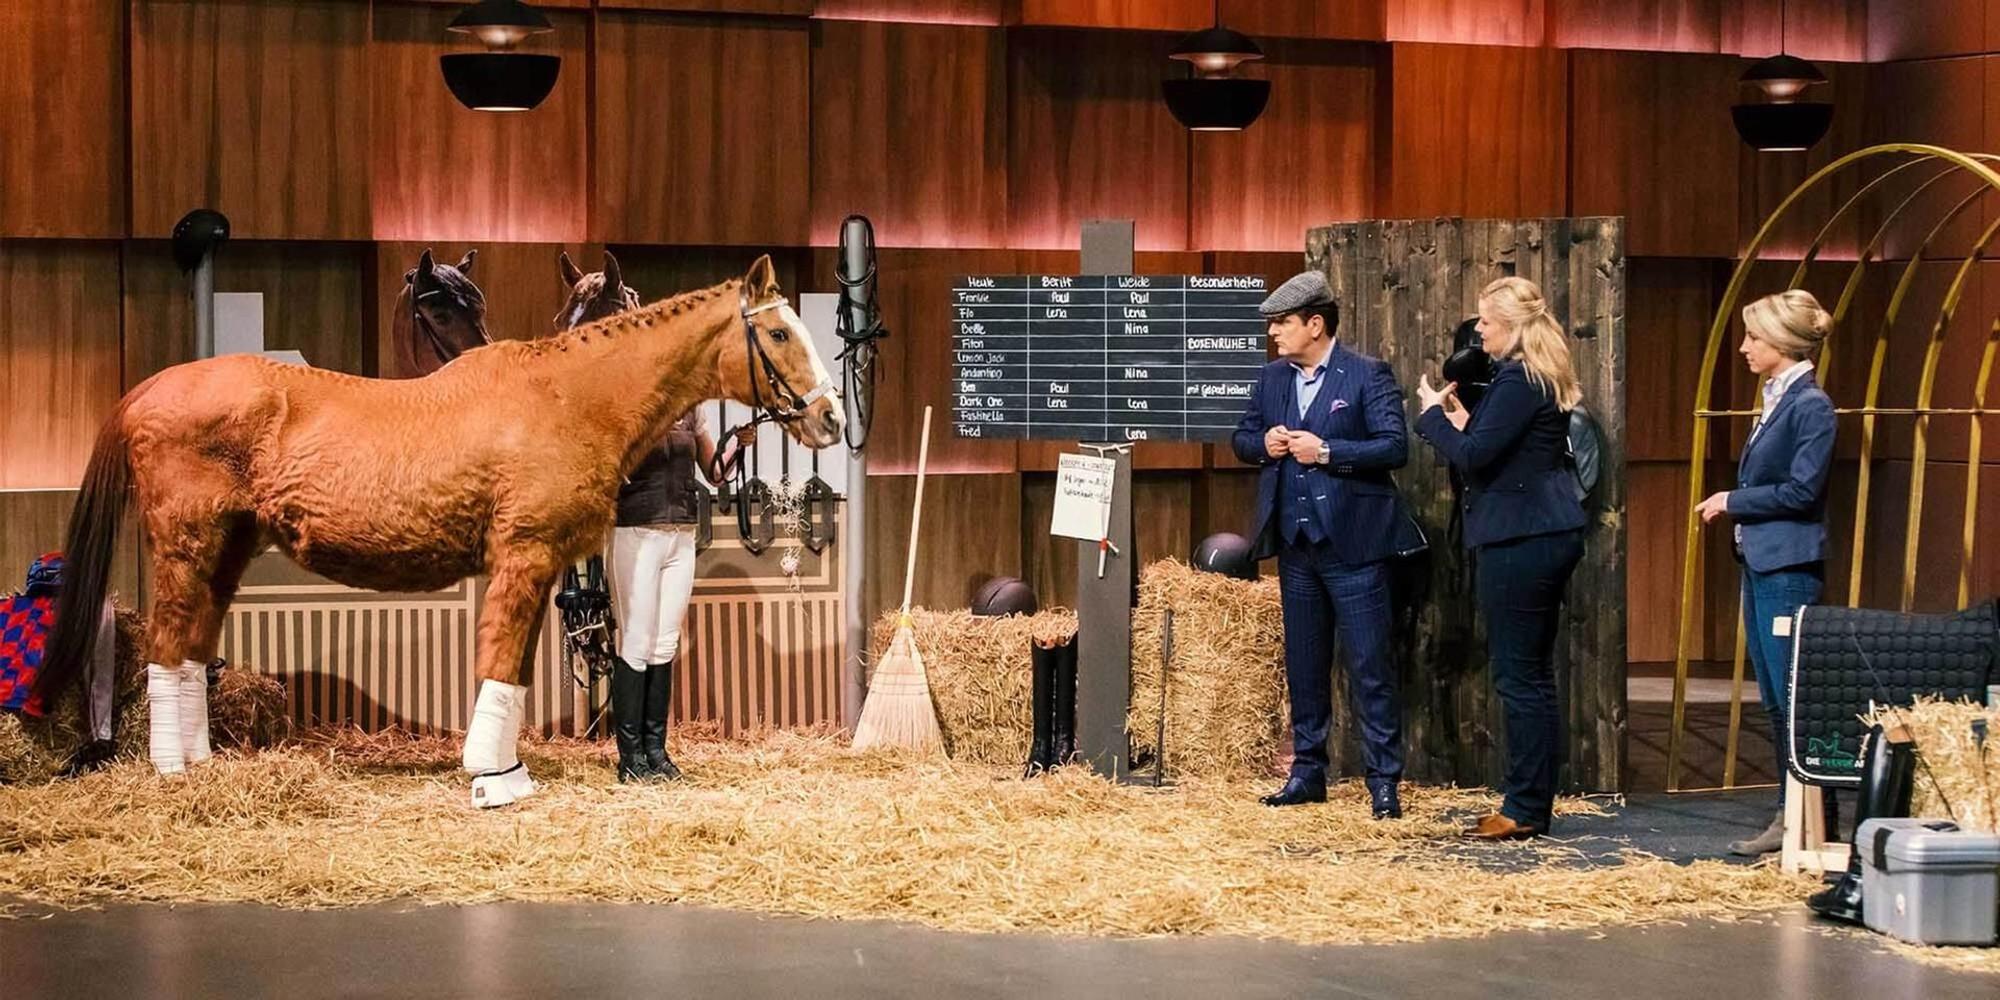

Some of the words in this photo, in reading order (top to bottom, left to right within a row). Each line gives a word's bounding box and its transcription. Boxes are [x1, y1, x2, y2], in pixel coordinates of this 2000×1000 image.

[968, 276, 995, 288] Heute
[1118, 276, 1151, 288] Weide
[1051, 291, 1070, 304] Paul
[1130, 291, 1150, 305] Paul
[958, 307, 975, 319] Flo
[1045, 307, 1068, 319] Lena
[1123, 307, 1147, 318] Lena
[1124, 322, 1149, 335] Nina
[1124, 367, 1149, 379] Nina
[1050, 382, 1070, 394] Paul
[959, 395, 983, 407] Dark
[986, 396, 1005, 407] One
[1046, 397, 1068, 409] Lena
[1127, 399, 1148, 410] Lena
[957, 424, 981, 438] Fred
[1124, 427, 1148, 441] Lena
[1805, 756, 1820, 766] DIE
